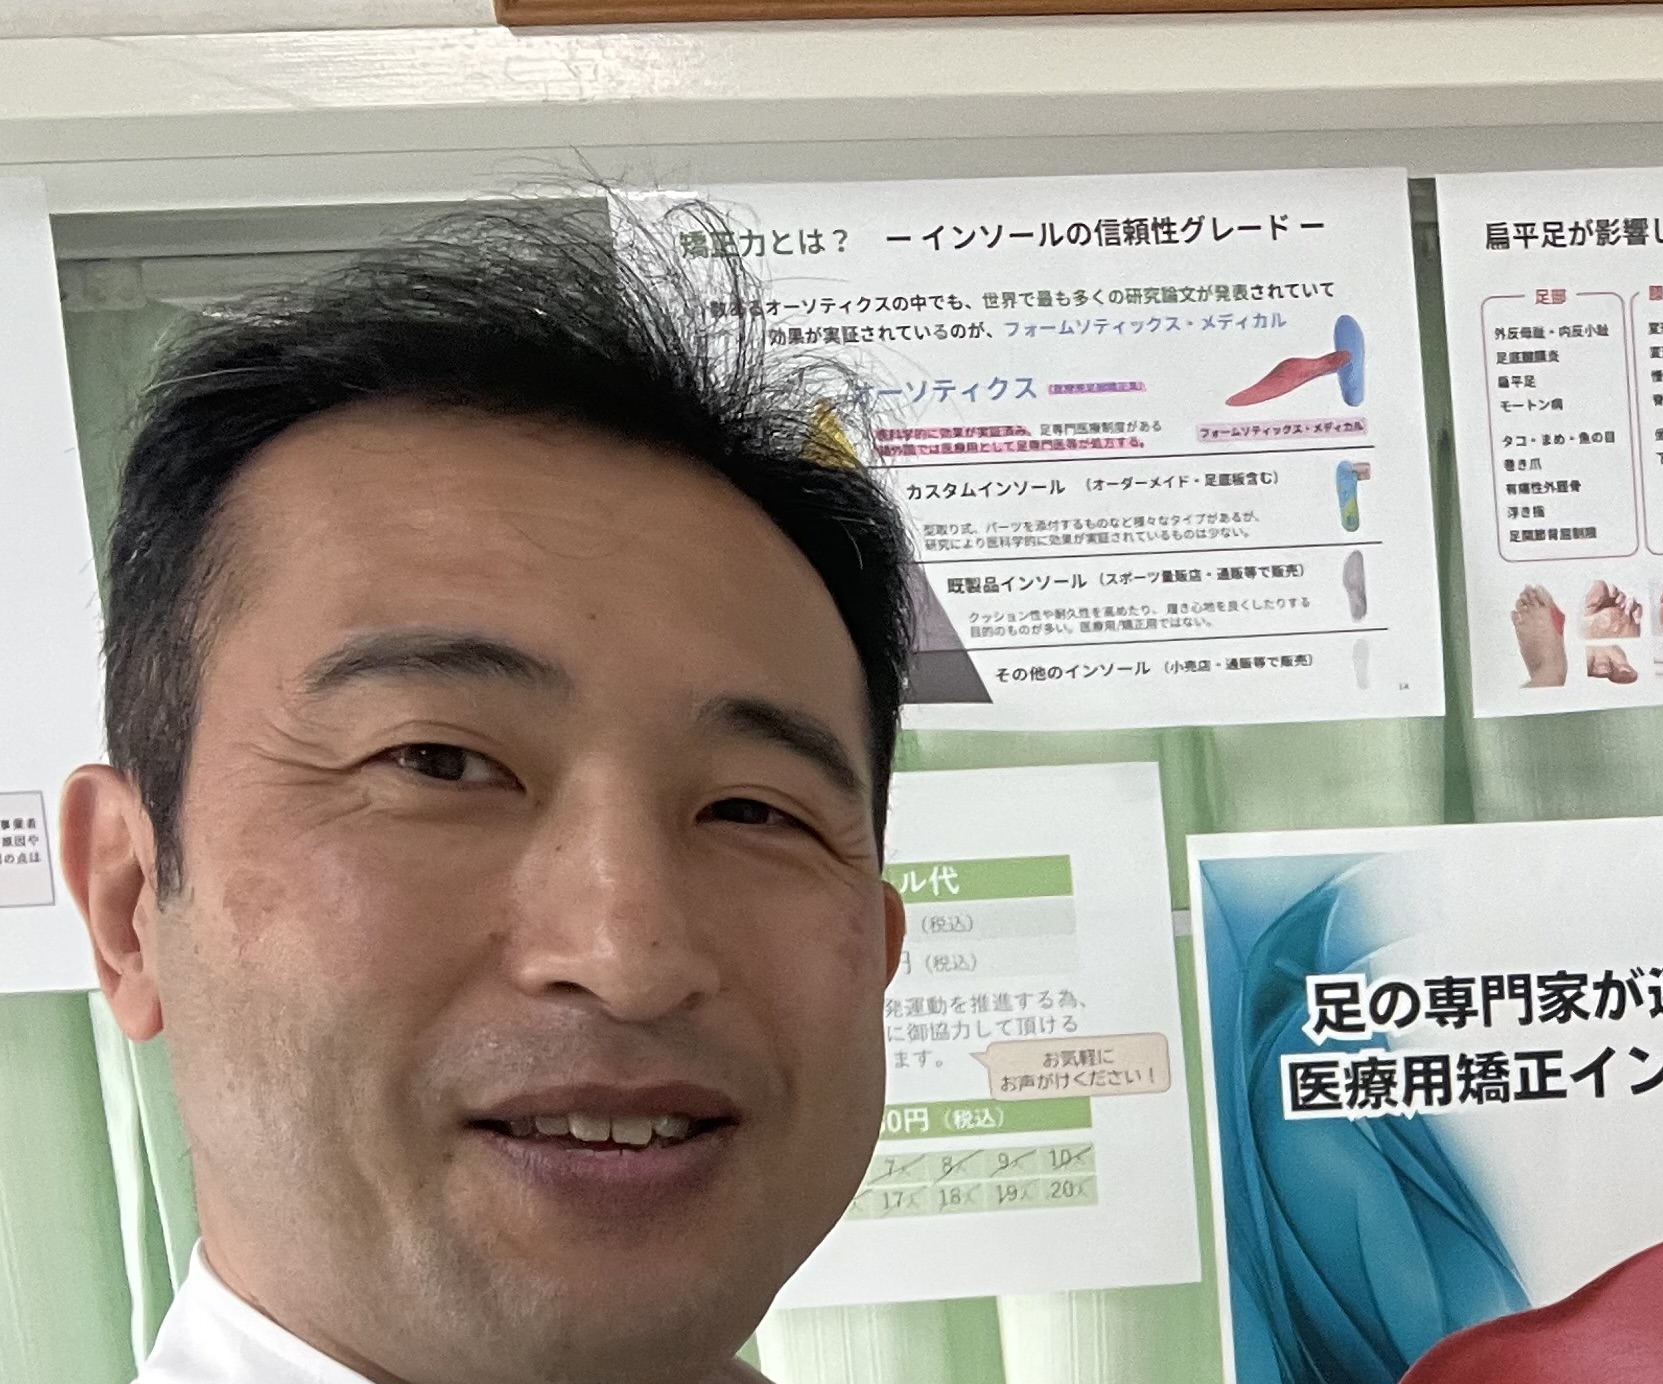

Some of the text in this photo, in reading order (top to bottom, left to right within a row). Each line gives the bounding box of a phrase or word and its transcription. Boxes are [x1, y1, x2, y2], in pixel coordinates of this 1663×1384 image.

[679, 228, 849, 258] 矯正力とは？
[906, 476, 1066, 501] カスタムインソール
[996, 661, 1150, 683] その他のインソール
[1043, 1049, 1115, 1068] お気軽に
[882, 1108, 930, 1134] 0円
